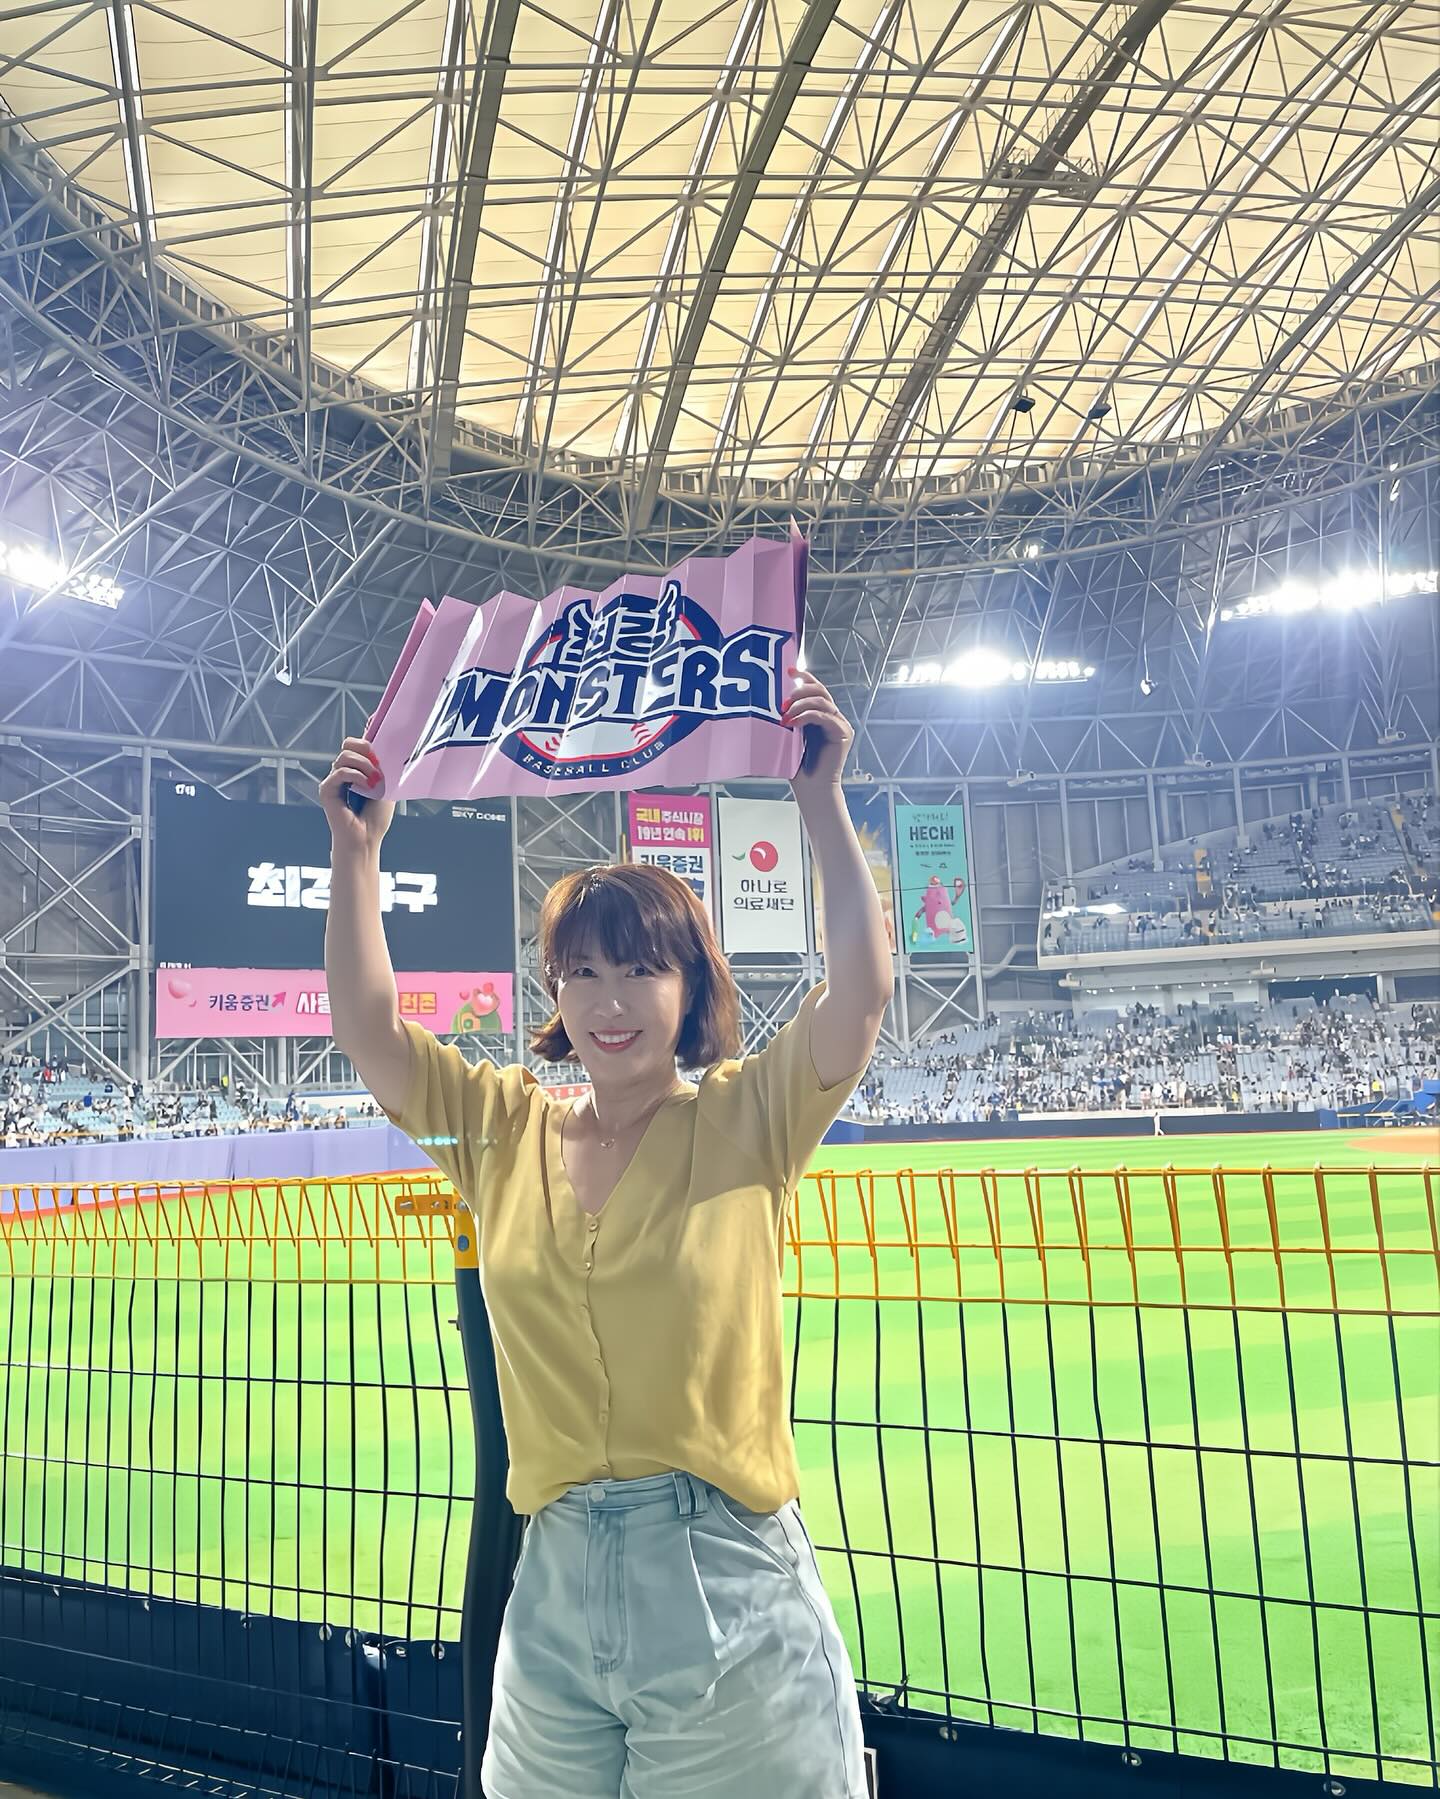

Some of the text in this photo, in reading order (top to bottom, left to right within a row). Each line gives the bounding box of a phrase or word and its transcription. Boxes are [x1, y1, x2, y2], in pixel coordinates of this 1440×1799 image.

[428, 626, 793, 747] MONSTERS
[522, 741, 665, 776] BASEBALL CLUB
[909, 825, 954, 841] HECHI
[741, 879, 787, 893] 아나로
[733, 897, 794, 911] 의료재단
[209, 993, 270, 1011] 키움증권
